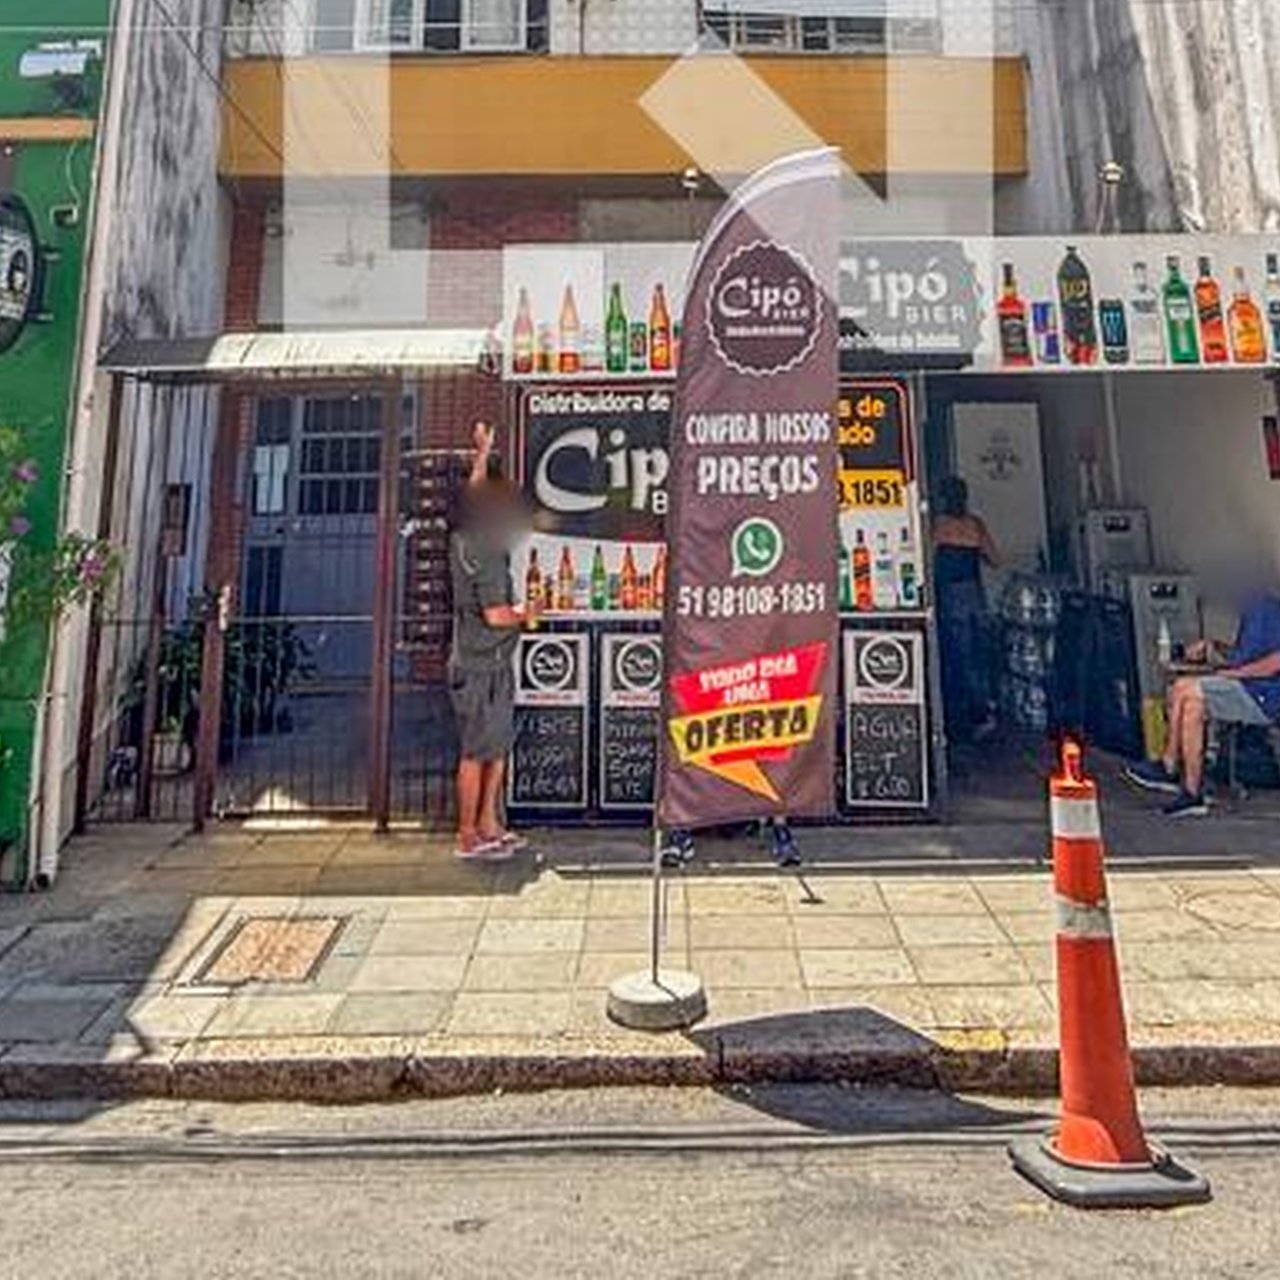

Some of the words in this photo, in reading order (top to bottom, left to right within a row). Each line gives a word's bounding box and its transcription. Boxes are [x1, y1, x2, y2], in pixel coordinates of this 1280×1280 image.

[718, 276, 801, 318] Cipó
[906, 304, 968, 324] BIER
[530, 392, 644, 414] Distribuidora
[646, 391, 670, 412] de
[856, 394, 886, 418] de
[686, 412, 760, 445] CONFIRA
[766, 411, 831, 444] NOSSOS
[534, 426, 670, 512] Cip
[697, 454, 820, 502] PREÇOS
[677, 584, 703, 616] 51
[699, 662, 757, 692] TODO
[759, 652, 799, 678] DIA
[724, 680, 770, 705] UMA
[685, 704, 808, 752] OFERTA
